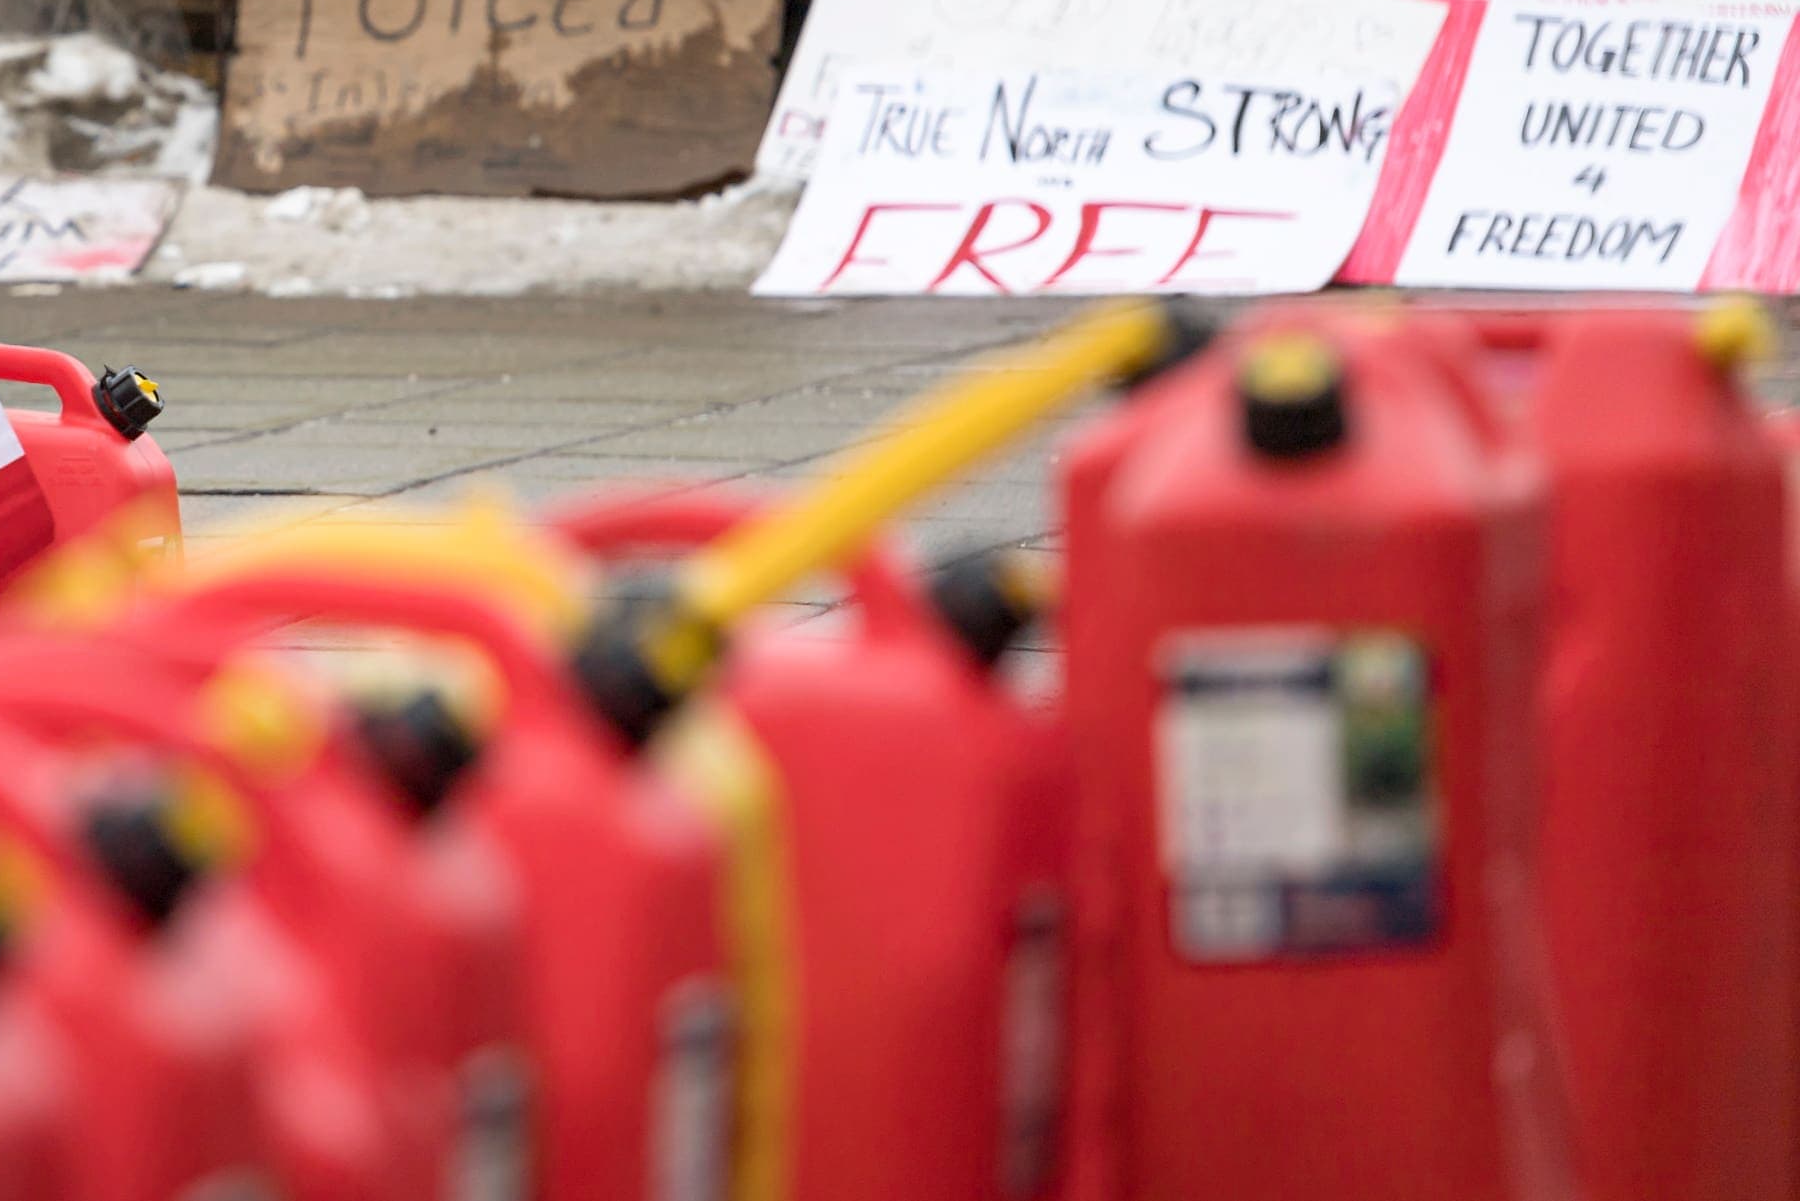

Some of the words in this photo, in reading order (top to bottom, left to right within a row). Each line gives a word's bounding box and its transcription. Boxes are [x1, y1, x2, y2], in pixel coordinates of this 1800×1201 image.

[1514, 12, 1761, 89] TOGETHER
[1519, 100, 1706, 153] UNITED
[1572, 163, 1608, 195] 4
[817, 196, 1300, 293] FREE
[1446, 208, 1688, 265] FREEDOM
